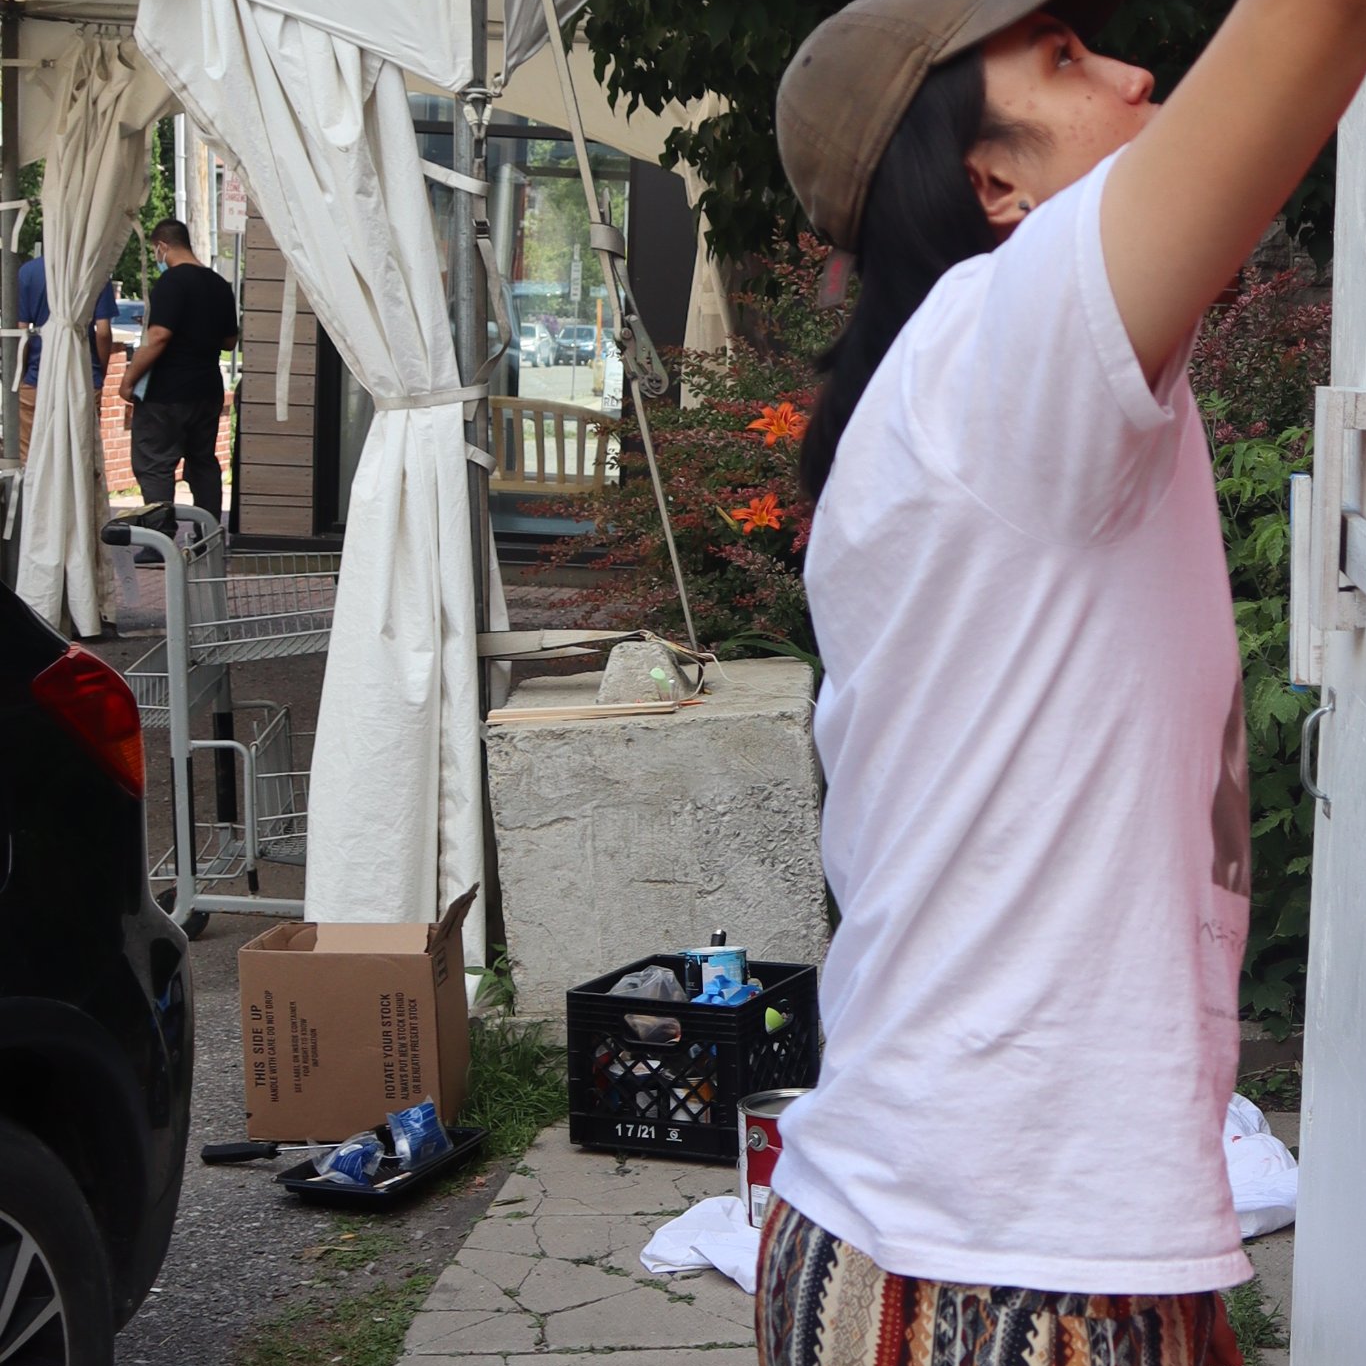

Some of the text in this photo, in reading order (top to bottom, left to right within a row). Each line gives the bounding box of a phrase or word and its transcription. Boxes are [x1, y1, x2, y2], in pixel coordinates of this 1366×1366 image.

[264, 990, 273, 1009] DROP
[266, 1011, 274, 1024] NOT
[290, 1001, 298, 1033] CONTAINER
[251, 1005, 266, 1087] THIS SIDE UP
[310, 1028, 319, 1067] INFORMATION
[380, 994, 396, 1099] ROTATE YOUR STOCK
[395, 993, 409, 1100] ALWAYS PUT NEW STOCK BEHIND
[408, 999, 422, 1094] OR BENEATH PRESENT STOCK
[268, 1057, 277, 1074] WITH
[293, 1065, 301, 1082] LABEL
[302, 1066, 310, 1077] FOR
[269, 1077, 279, 1102] HANDLE
